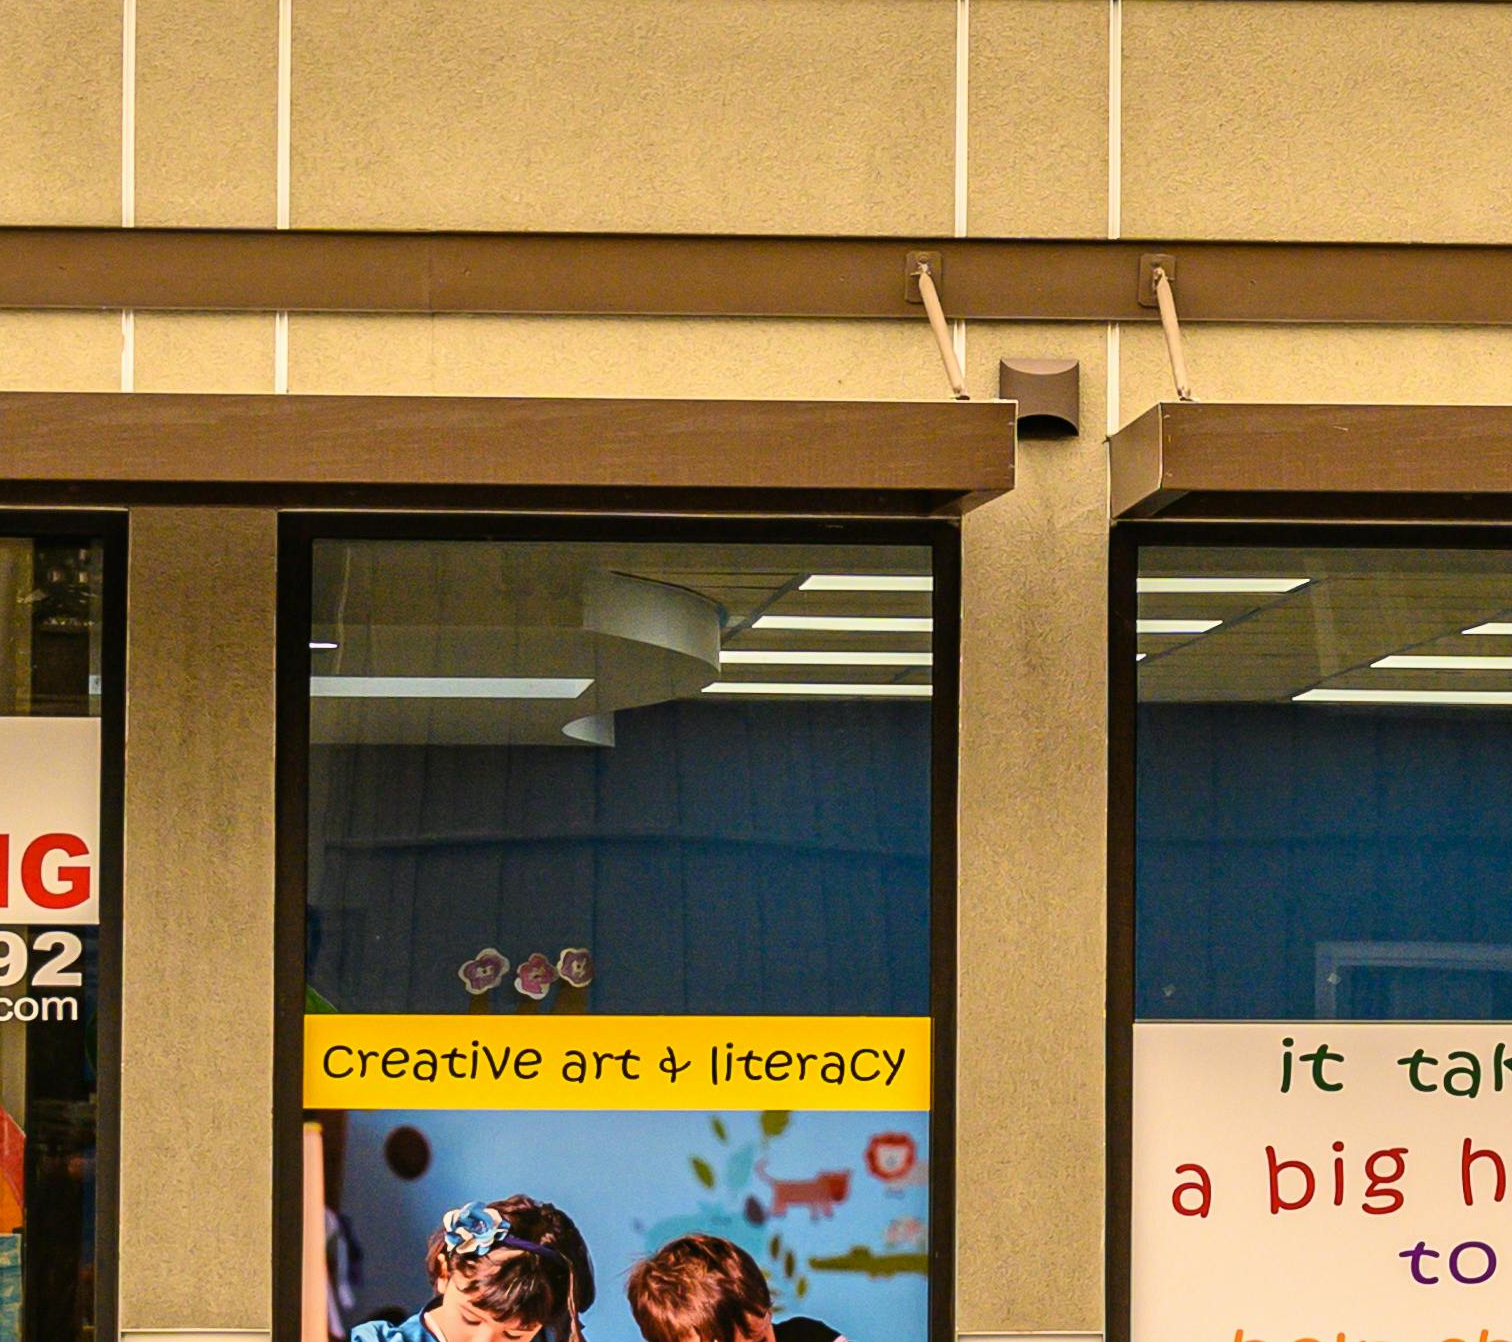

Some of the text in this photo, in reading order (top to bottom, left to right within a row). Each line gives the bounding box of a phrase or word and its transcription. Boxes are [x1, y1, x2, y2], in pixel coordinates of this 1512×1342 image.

[562, 1048, 640, 1082] art
[659, 1047, 691, 1083] &
[710, 1043, 905, 1085] literacy
[1280, 1038, 1345, 1093] it
[1172, 1163, 1212, 1218] a
[1265, 1141, 1409, 1215] big
[1399, 1241, 1497, 1285] to
